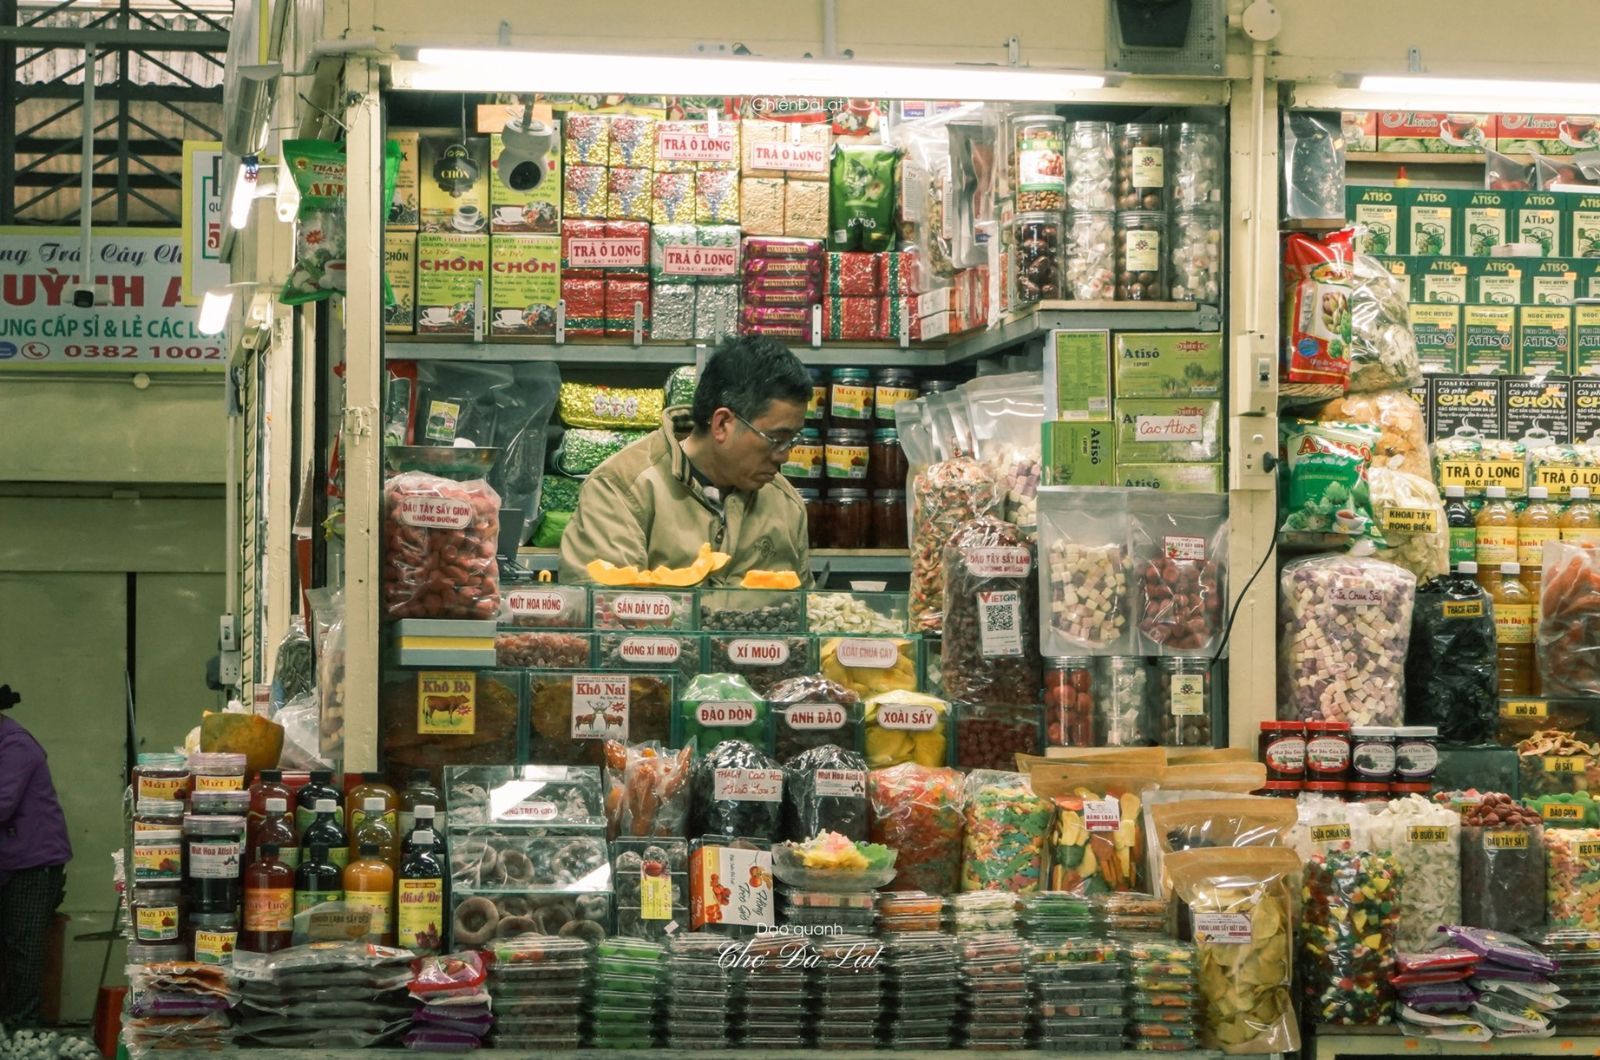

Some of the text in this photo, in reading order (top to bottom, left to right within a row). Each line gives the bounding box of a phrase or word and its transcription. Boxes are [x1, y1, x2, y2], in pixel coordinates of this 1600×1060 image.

[701, 138, 731, 151] LONG
[1362, 192, 1392, 202] ATISO
[1416, 193, 1447, 203] ATISO
[1470, 194, 1501, 205] ATISO
[1525, 196, 1556, 206] ATISO
[100, 242, 144, 267] Cây
[611, 245, 641, 258] LONG
[704, 253, 734, 266] LONG
[1485, 262, 1516, 272] ATISO
[1540, 263, 1569, 274] ATISO
[42, 314, 78, 337] CẤP
[83, 313, 99, 337] SỈ
[104, 320, 117, 337] &
[122, 314, 142, 338] LẺ
[147, 316, 184, 339] CÁC
[1468, 333, 1512, 347] ATISÔ
[1523, 334, 1568, 348] ATISÔ
[64, 344, 227, 360] 0382 1002
[1124, 348, 1160, 359] Atisô
[1090, 428, 1102, 464] Atisô
[1446, 464, 1520, 478] TRÀ Ô LONG
[1542, 471, 1566, 484] TRÀ
[1571, 471, 1579, 484] Ô
[1390, 510, 1414, 518] KHOAI
[1389, 523, 1411, 531] RONG
[527, 598, 540, 610] HOA
[646, 644, 655, 656] XÍ
[657, 646, 678, 658] MUỘI
[736, 646, 780, 660] XÍ MUỘI
[576, 682, 626, 696] Khô Nai
[701, 706, 724, 721] ĐÀO
[791, 708, 842, 724] ANH ĐÀO
[884, 708, 933, 724] XOÀI SẤY
